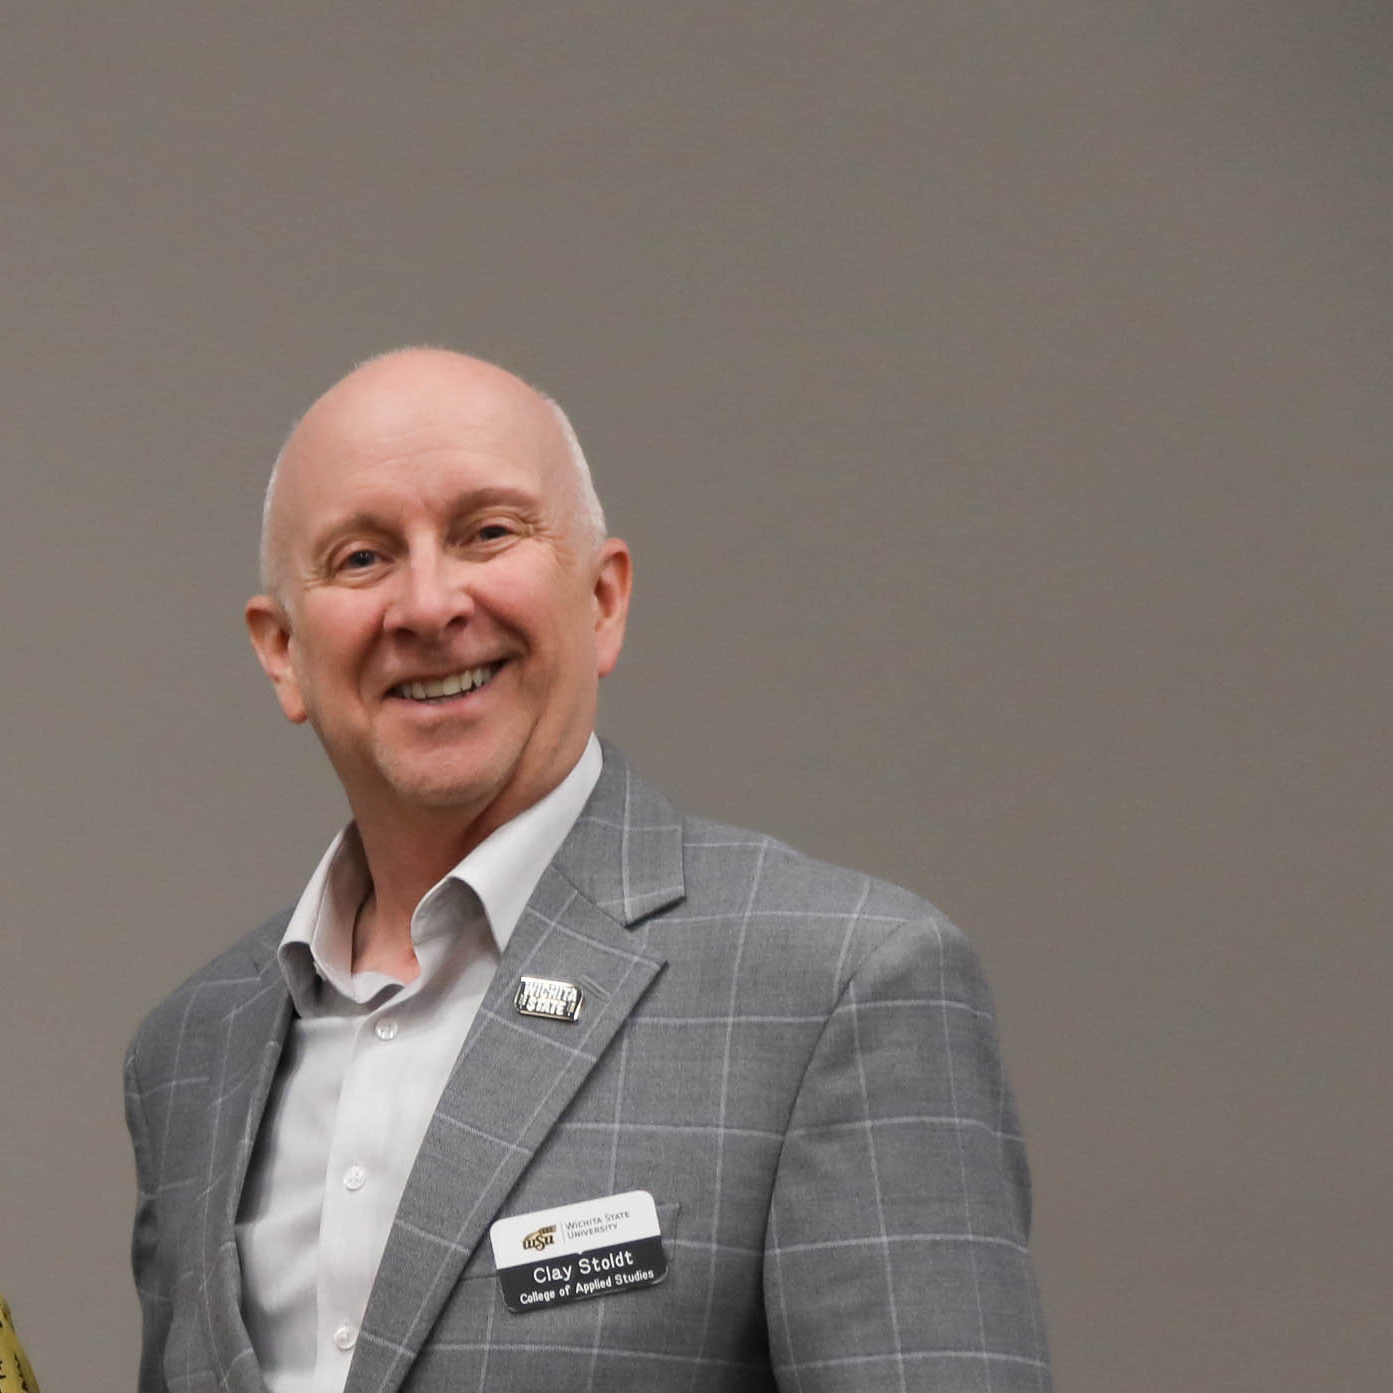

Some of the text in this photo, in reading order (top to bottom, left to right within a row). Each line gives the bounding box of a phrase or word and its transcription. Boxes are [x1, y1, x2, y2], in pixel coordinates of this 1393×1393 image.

[526, 997, 566, 1016] STATE
[533, 1250, 634, 1284] Clay Stoldt
[519, 1268, 655, 1305] College of Applied Studies
